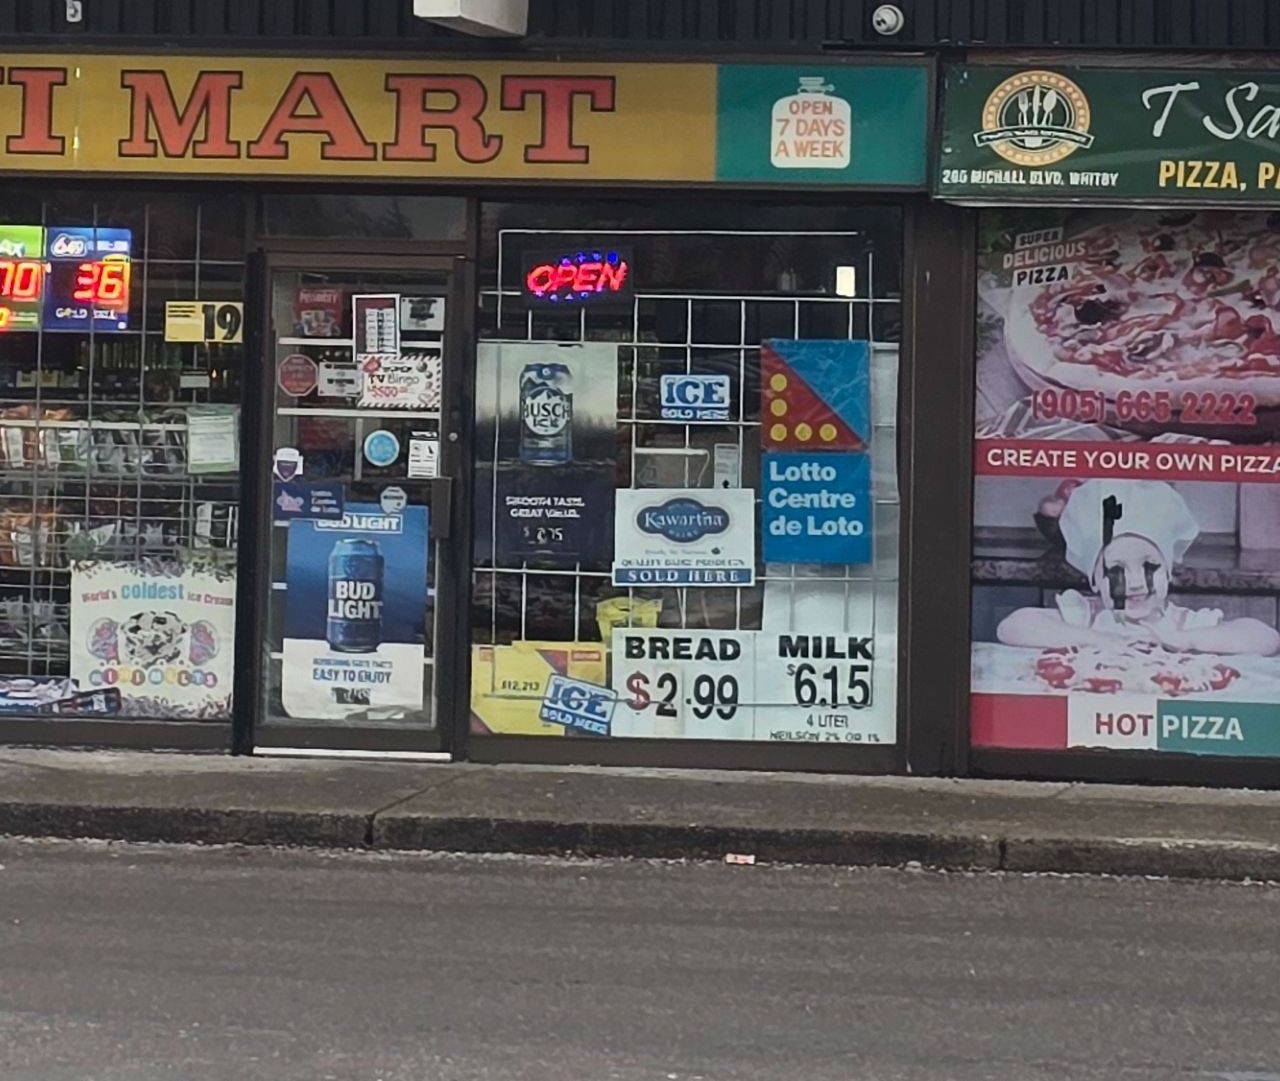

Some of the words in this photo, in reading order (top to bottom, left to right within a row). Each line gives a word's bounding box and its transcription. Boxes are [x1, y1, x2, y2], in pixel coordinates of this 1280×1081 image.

[119, 69, 616, 164] MART
[789, 101, 832, 114] OPEN
[775, 119, 789, 136] 7
[796, 119, 844, 136] DAYS
[774, 140, 789, 157] A
[794, 140, 844, 157] WEEK
[1070, 173, 1118, 186] WHITBY
[1159, 160, 1246, 192] PIZZA,
[1020, 231, 1058, 245] SUPER
[1003, 242, 1085, 269] DELICIOUS
[526, 261, 628, 293] OPEN
[1017, 266, 1068, 286] PIZZA
[202, 304, 241, 340] 19
[666, 381, 724, 404] ICE
[1032, 391, 1106, 421] (905)
[1116, 391, 1173, 421] 665
[1181, 393, 1257, 424] 2222
[987, 449, 1077, 467] CREATE
[1083, 451, 1150, 469] YOUR
[1156, 453, 1214, 471] OWN
[769, 461, 836, 481] Lotto
[769, 487, 856, 508] Centre
[353, 514, 399, 530] LIGHT
[770, 515, 802, 536] de
[807, 515, 864, 536] Loto
[628, 570, 678, 582] SOLD
[121, 582, 184, 600] coldest
[336, 581, 375, 599] BUD
[329, 598, 382, 619] LIGHT
[625, 636, 741, 661] BREAD
[778, 635, 874, 660] MILK
[343, 669, 356, 682] TO
[549, 677, 608, 719] ICE
[1095, 713, 1154, 737] HOT
[1162, 715, 1245, 741] PIZZA
